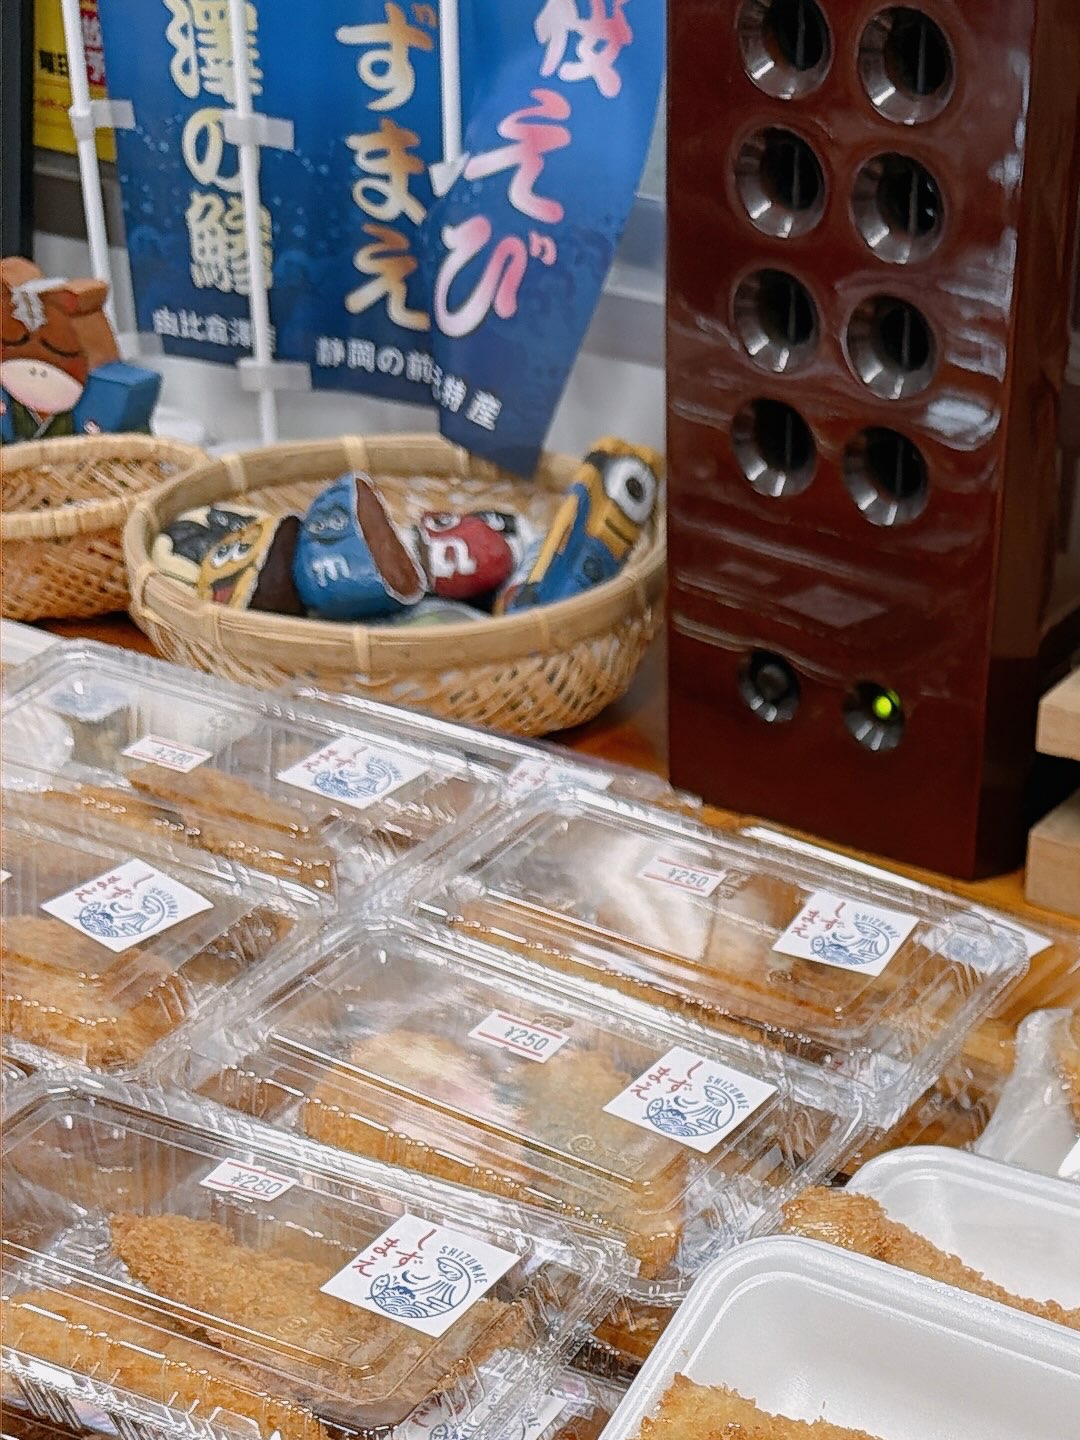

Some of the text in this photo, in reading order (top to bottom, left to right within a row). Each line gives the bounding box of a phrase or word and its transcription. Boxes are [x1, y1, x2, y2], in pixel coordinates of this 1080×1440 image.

[335, 2, 437, 332] ずまえ
[668, 867, 709, 888] ¥250
[504, 1025, 549, 1051] ¥250
[231, 1171, 283, 1194] ¥280
[439, 1245, 488, 1285] SHIZUMAE
